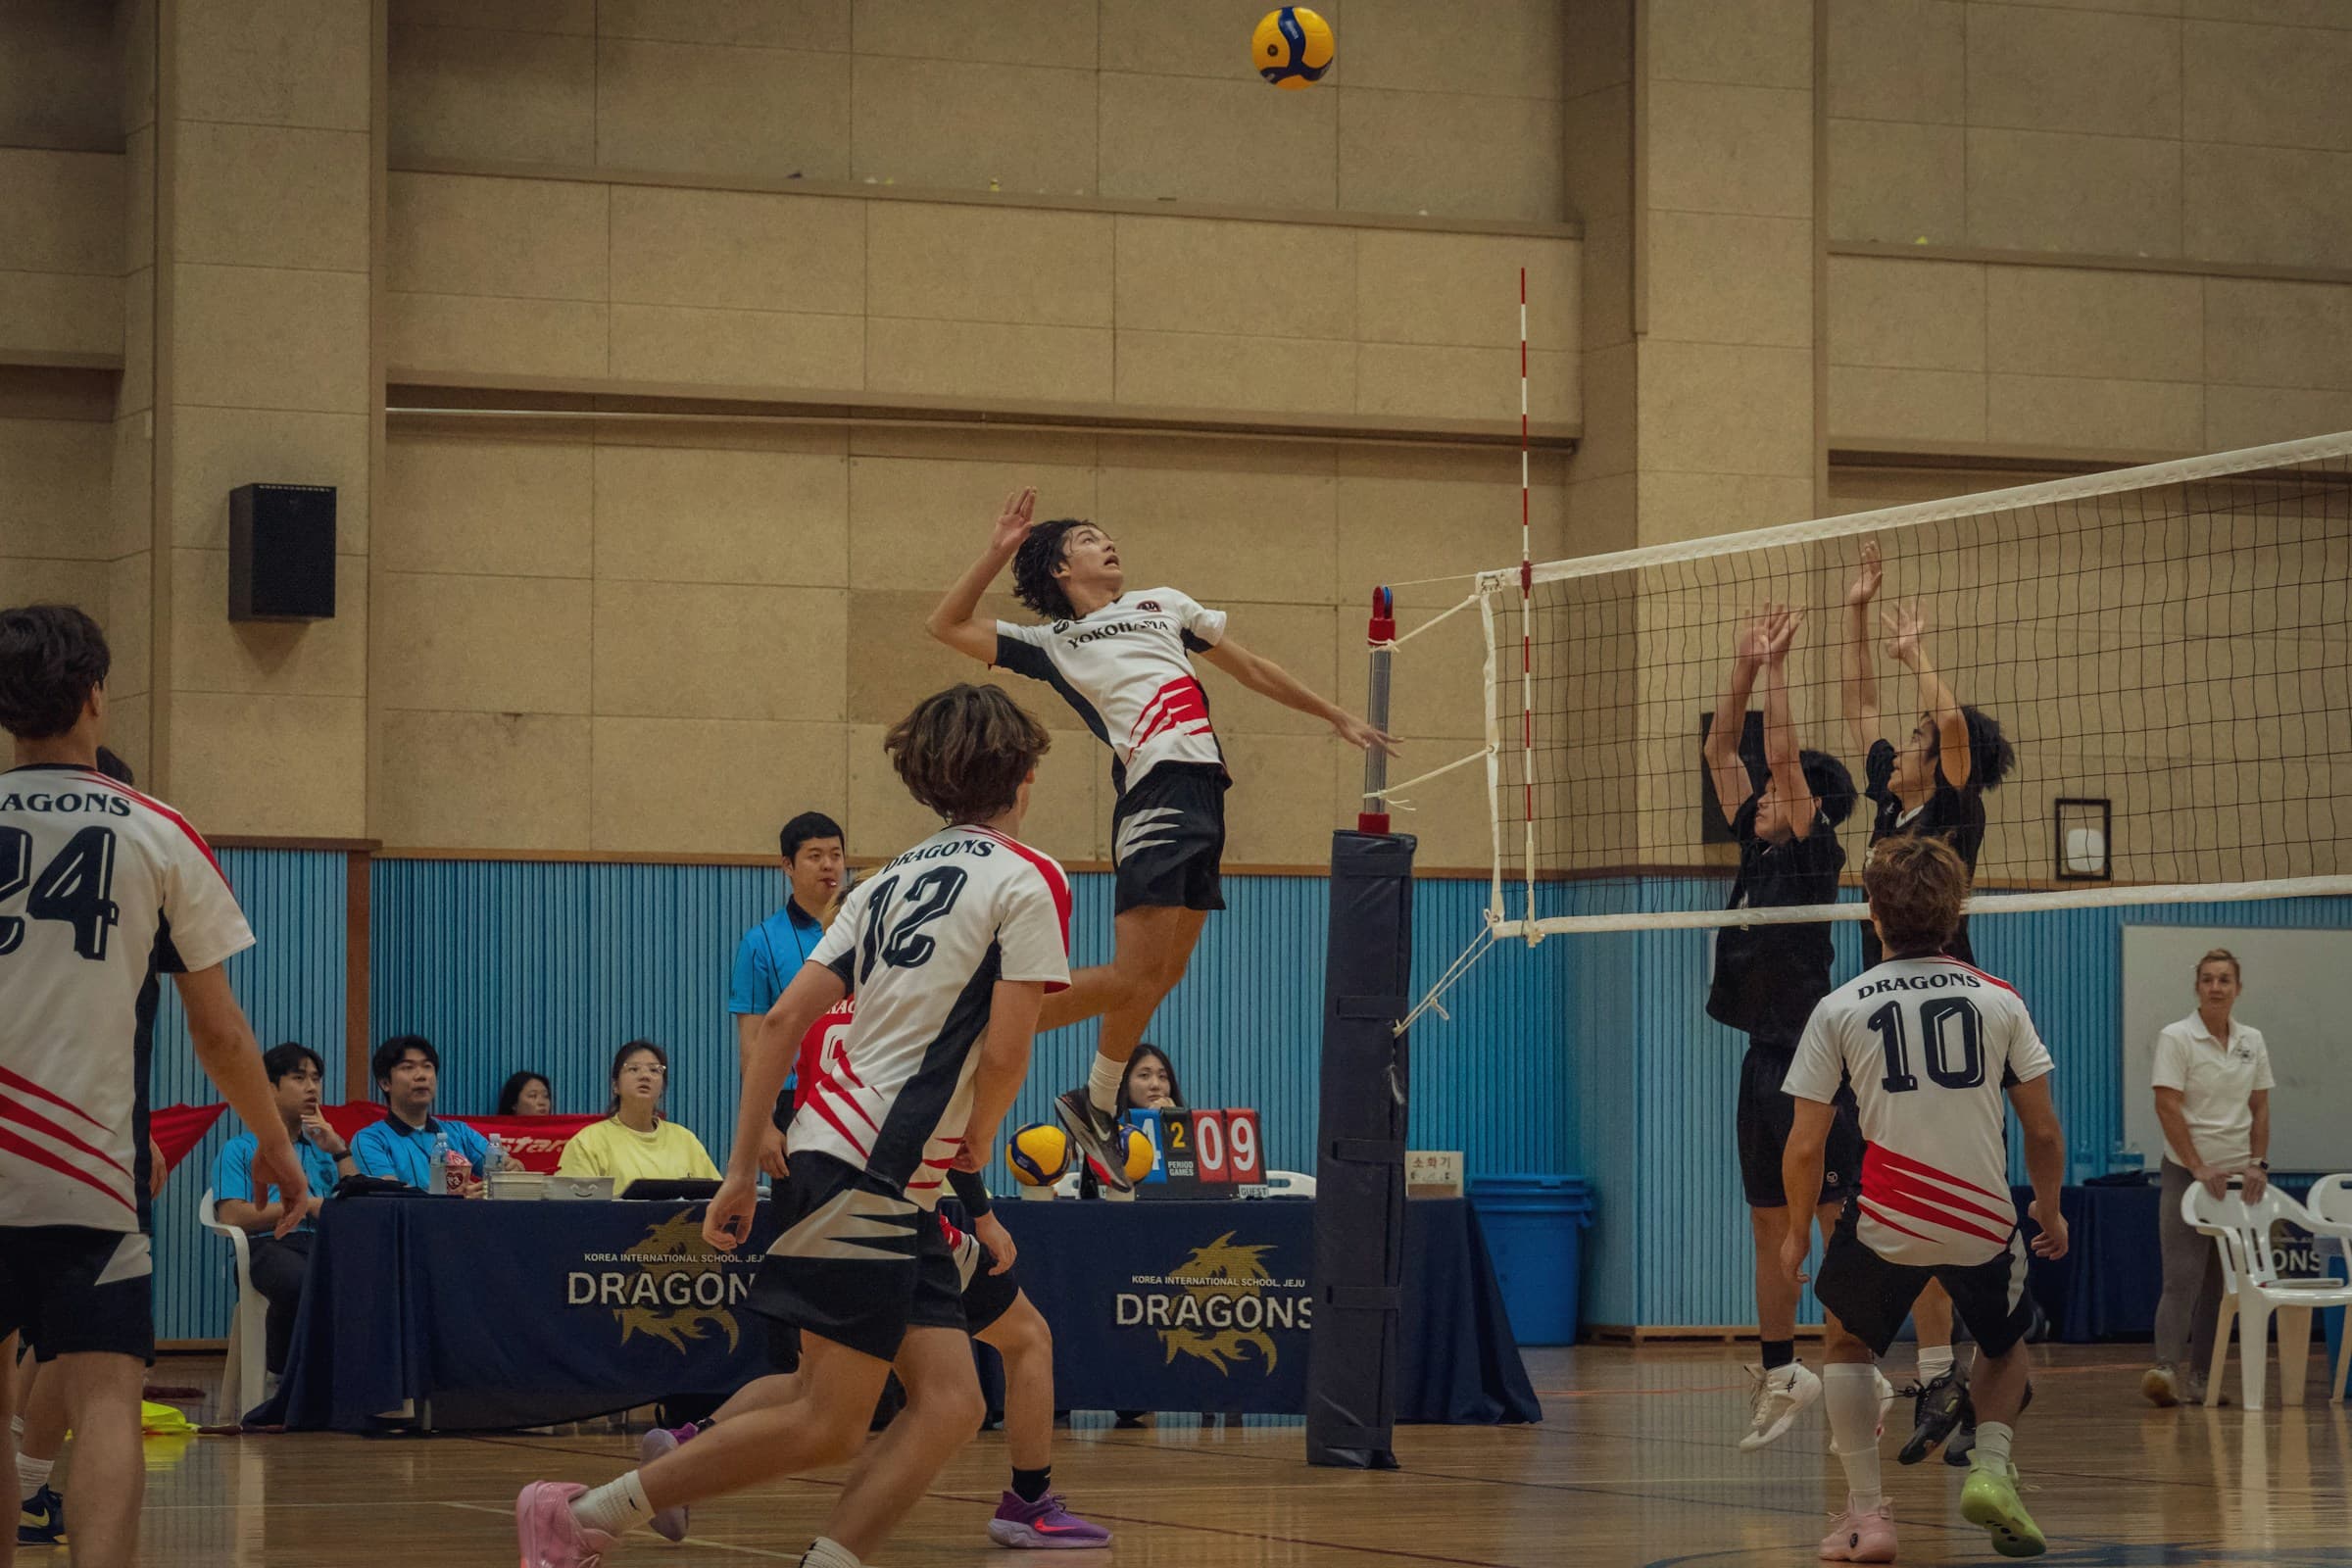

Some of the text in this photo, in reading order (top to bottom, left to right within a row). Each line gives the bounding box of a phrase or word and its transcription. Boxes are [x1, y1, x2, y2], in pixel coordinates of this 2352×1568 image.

[1068, 620, 1168, 650] YOKOHAMA
[883, 839, 996, 874] DRAGONS
[858, 865, 968, 985] 12
[1857, 973, 1982, 1000] DRAGONS
[1867, 997, 1985, 1093] 10
[1170, 1122, 1186, 1148] 2
[1198, 1116, 1255, 1171] 09
[584, 1253, 617, 1262] KOREA
[620, 1253, 698, 1263] INTERNATIONAL
[745, 1254, 764, 1263] JEJ
[1132, 1275, 1162, 1285] KOREA
[1165, 1276, 1239, 1287] INTERNATIONAL
[1283, 1278, 1305, 1288] JEJU
[1116, 1293, 1313, 1329] DRAGONS
